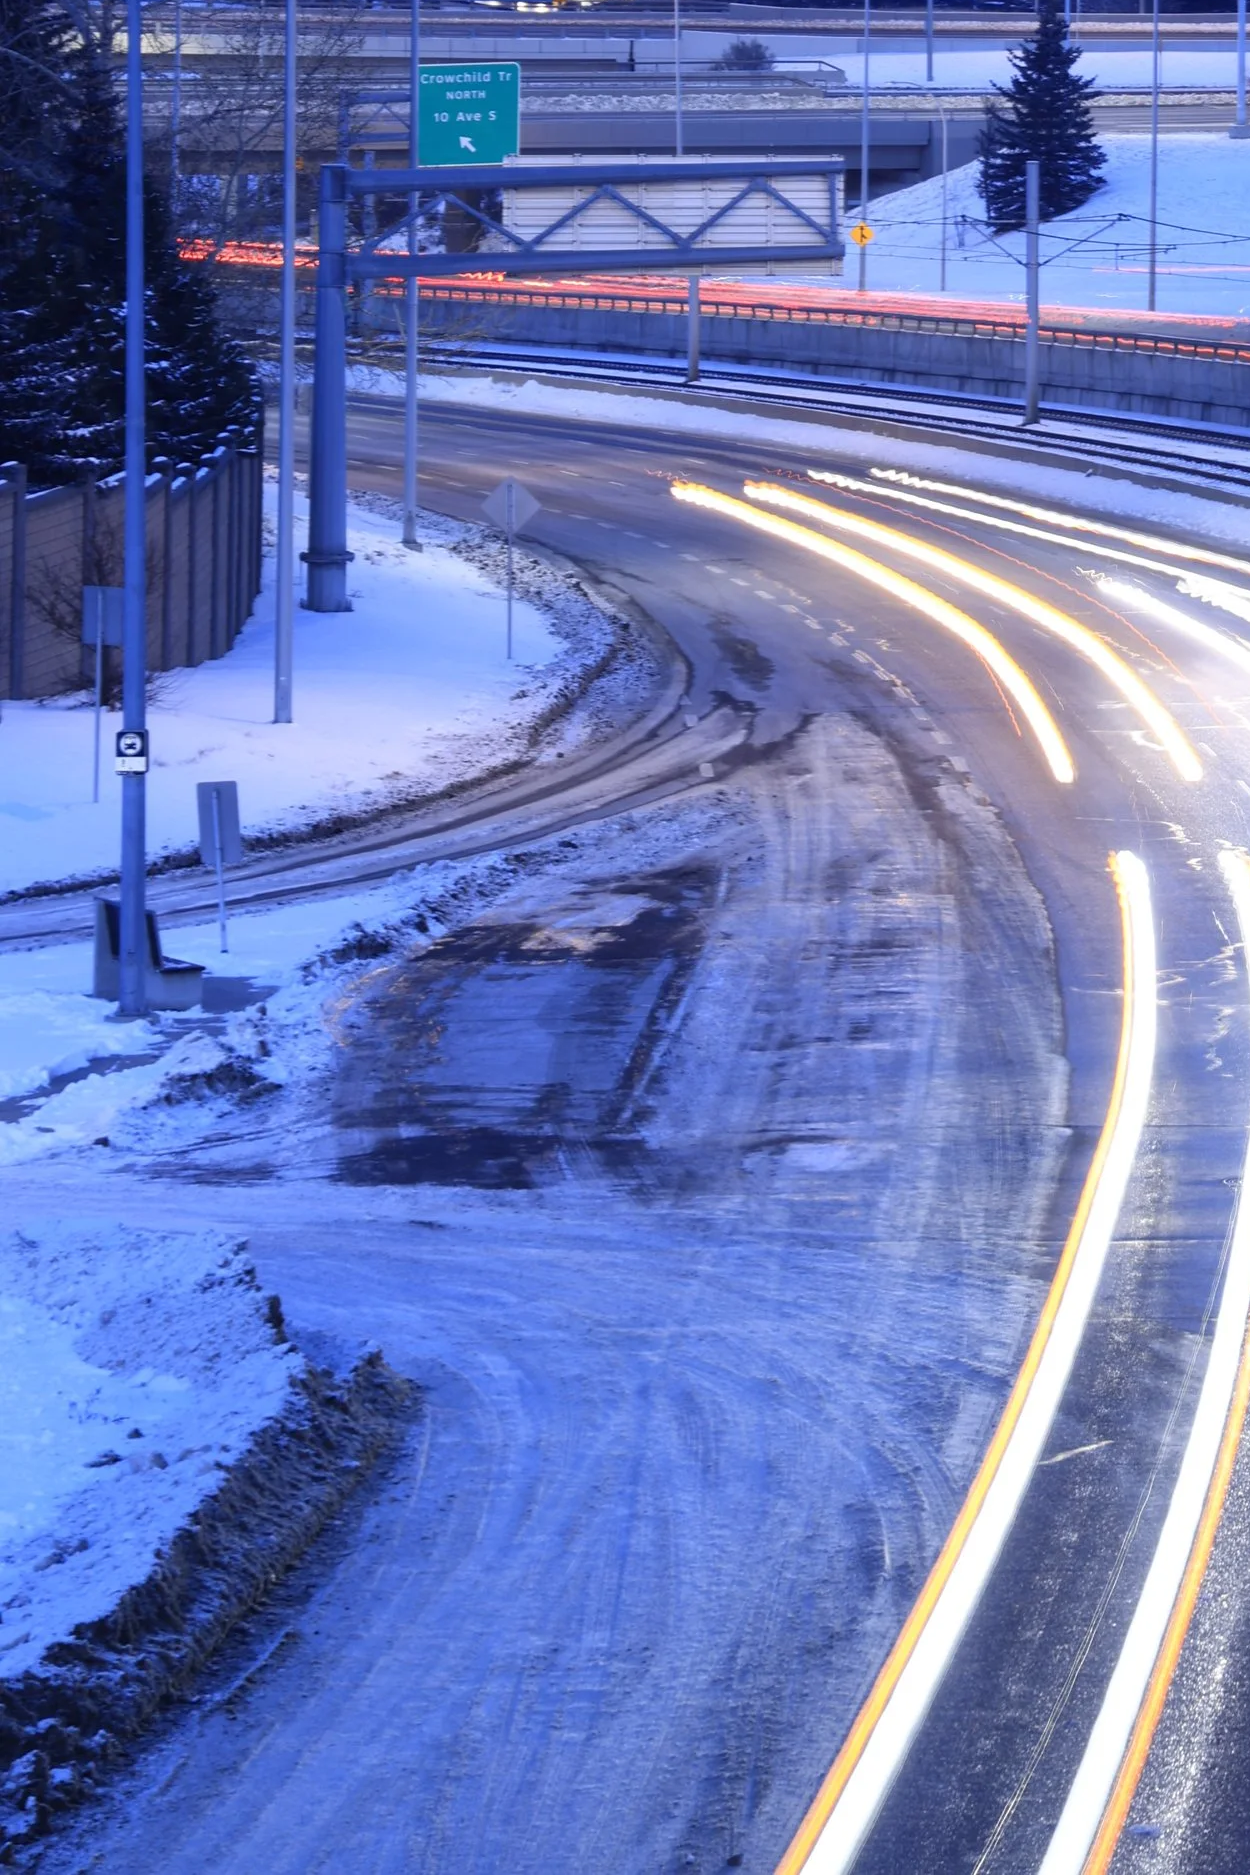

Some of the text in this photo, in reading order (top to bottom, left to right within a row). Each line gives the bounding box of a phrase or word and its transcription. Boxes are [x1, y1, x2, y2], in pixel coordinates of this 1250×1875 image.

[420, 71, 513, 84] Crowchild Tr
[445, 90, 486, 100] NORTH
[433, 110, 497, 123] 10 Ave S
